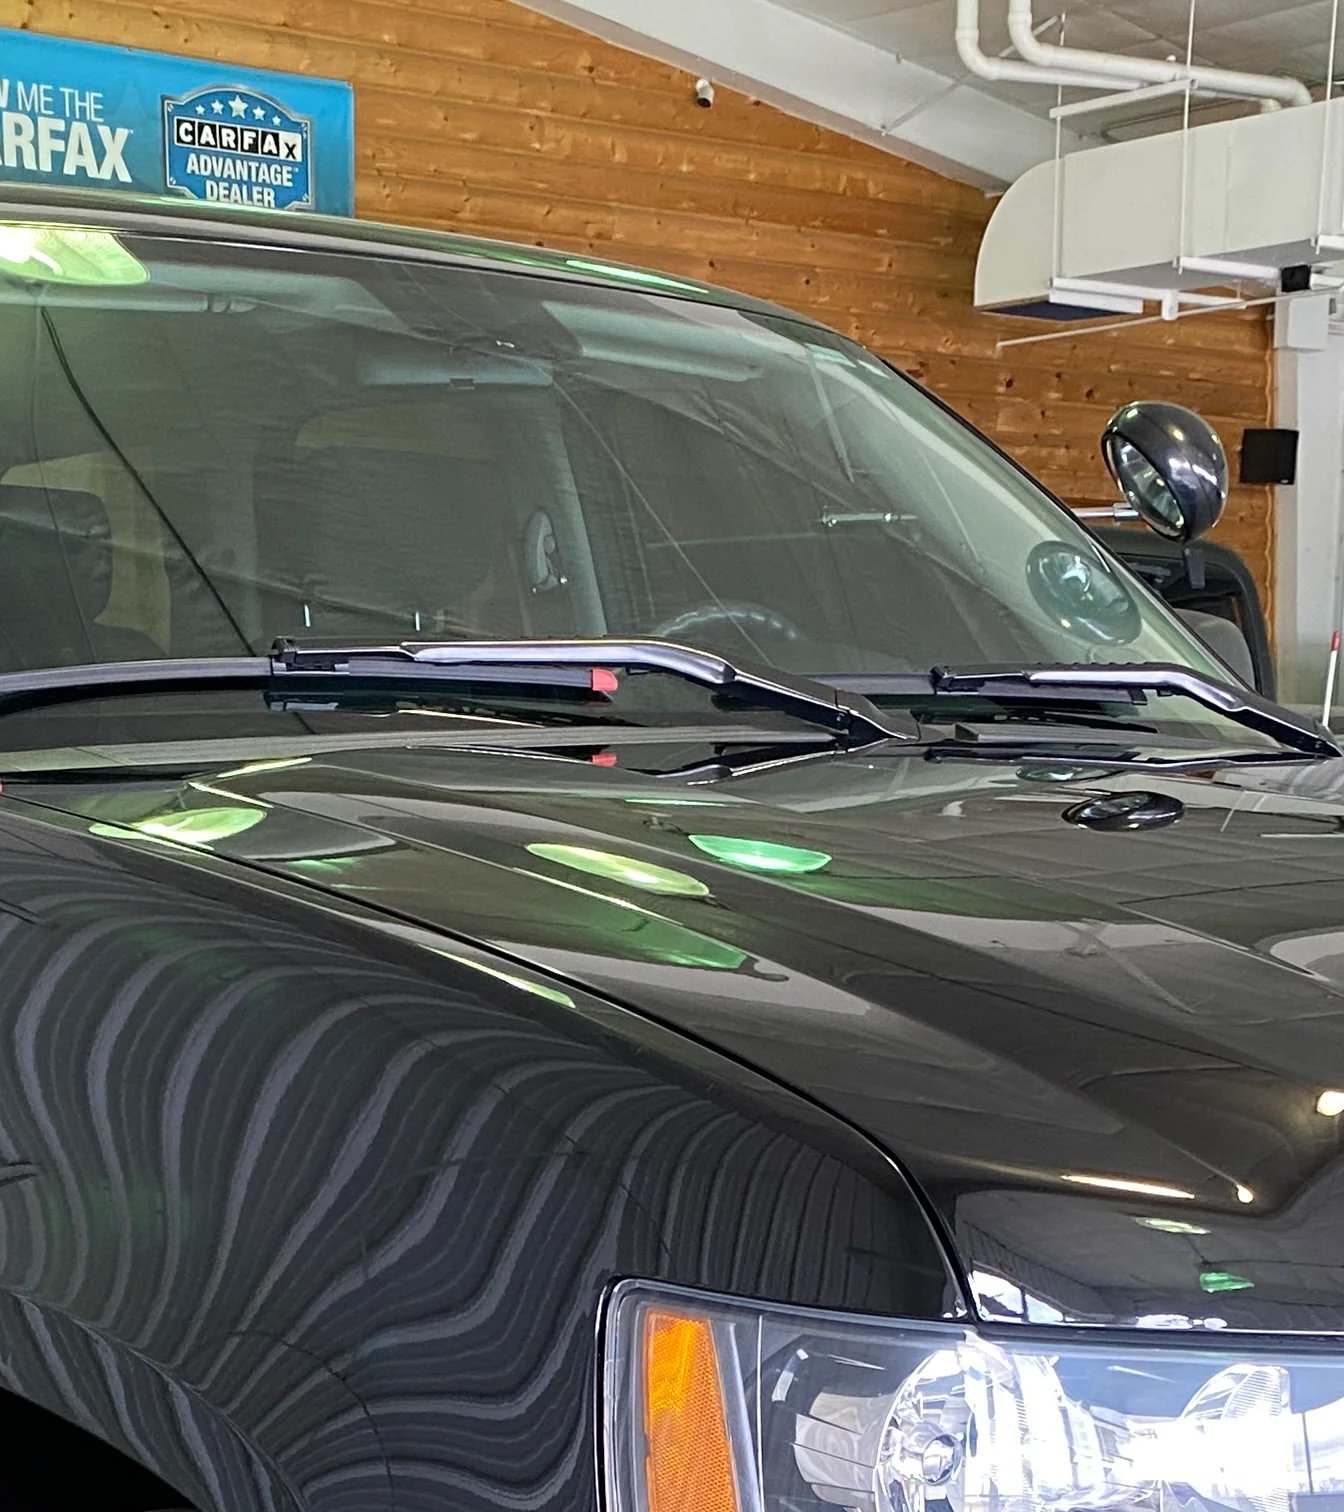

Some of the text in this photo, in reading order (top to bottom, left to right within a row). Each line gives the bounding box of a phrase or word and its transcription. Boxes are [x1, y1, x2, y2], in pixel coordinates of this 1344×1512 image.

[17, 80, 55, 116] ME
[59, 87, 105, 123] THE
[178, 121, 297, 160] CARFAX
[186, 152, 294, 187] ADVANTAGE
[205, 179, 276, 208] DEALER
